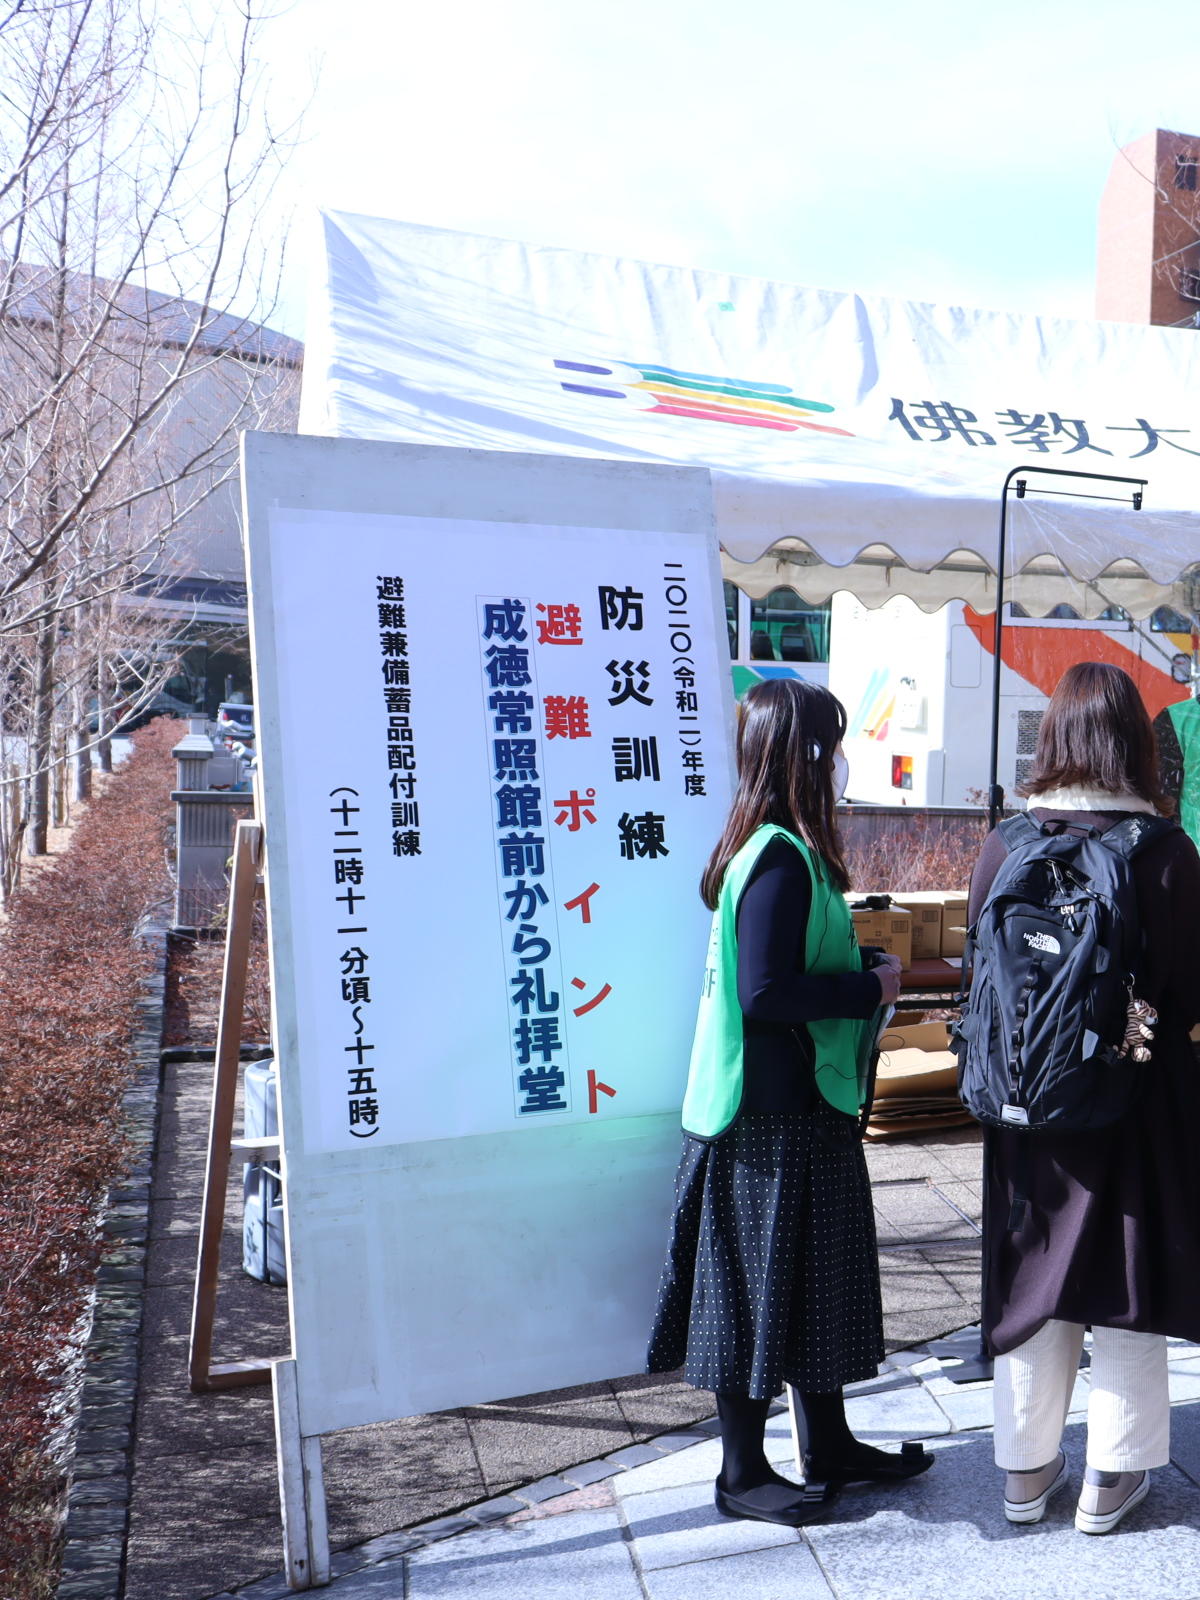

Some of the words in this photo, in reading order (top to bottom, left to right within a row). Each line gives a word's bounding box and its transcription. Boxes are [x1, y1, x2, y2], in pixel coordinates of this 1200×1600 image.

[376, 575, 422, 857] 避難兼備蓄品配付訓練
[598, 585, 671, 861] 防災訓練
[663, 563, 707, 797] 二〇二〇（令和二）年度
[483, 598, 568, 1114] 成徳常照館前から礼拝堂
[537, 603, 617, 1114] 避難ポイント
